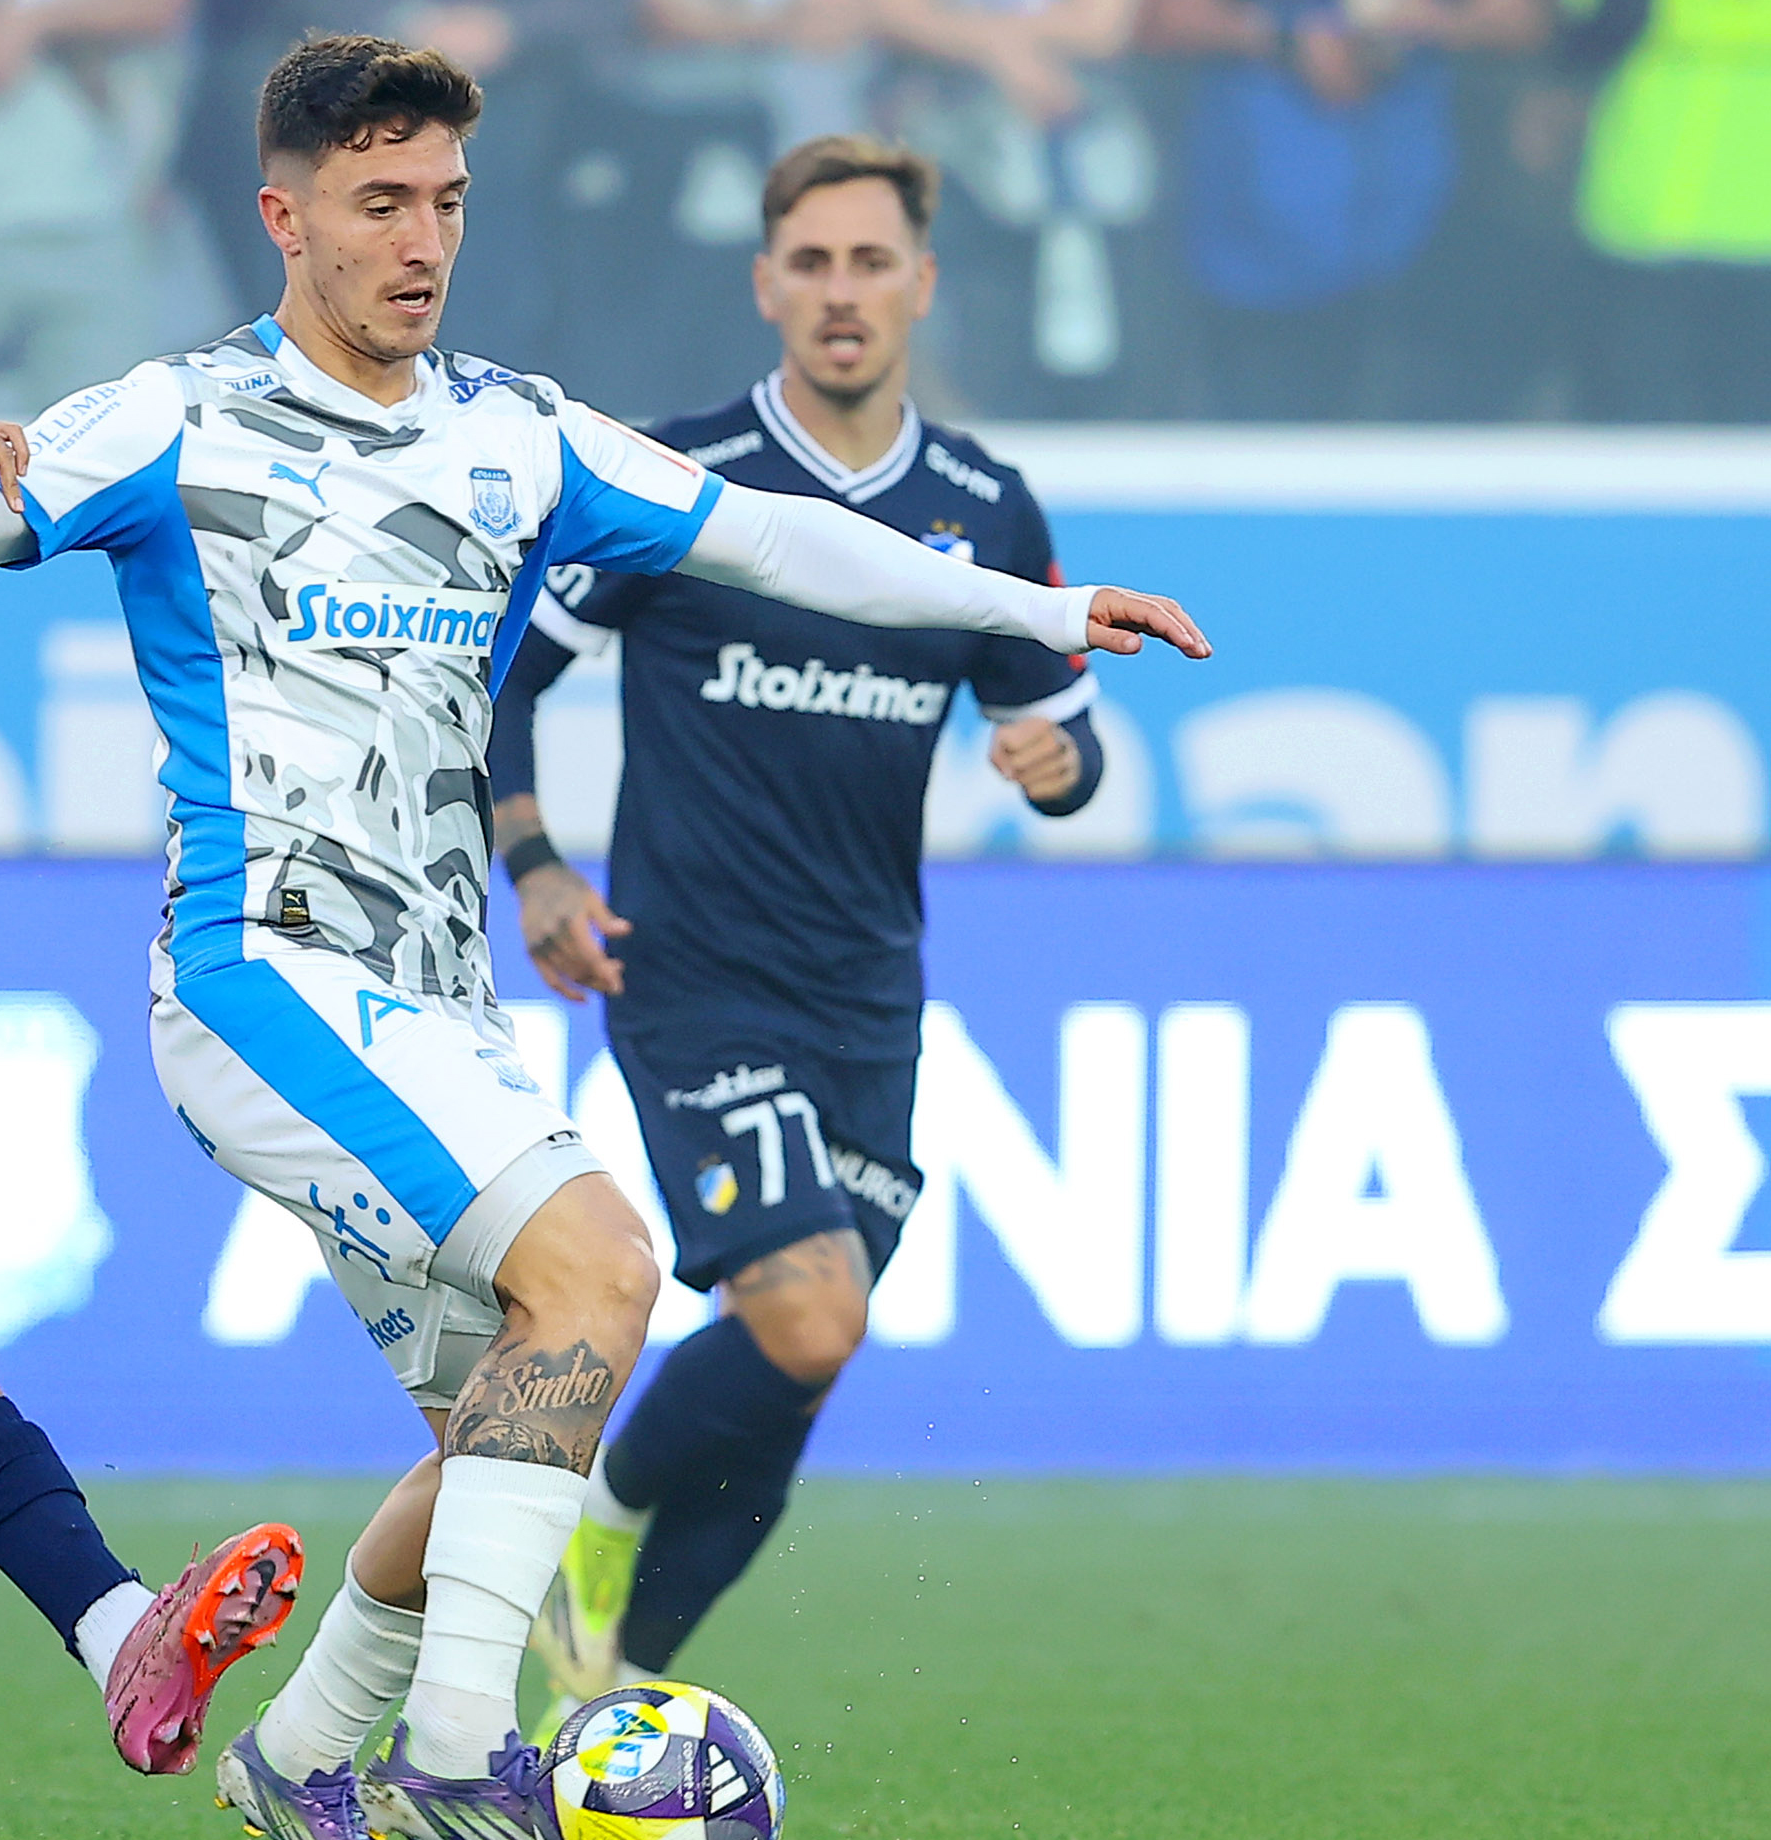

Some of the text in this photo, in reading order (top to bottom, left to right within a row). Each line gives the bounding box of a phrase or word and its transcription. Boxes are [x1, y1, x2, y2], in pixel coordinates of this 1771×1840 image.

[27, 379, 139, 457] OLUMBI
[56, 400, 122, 454] RESTAURANTS
[287, 583, 496, 647] Stoixima
[721, 1090, 837, 1208] 77
[364, 1307, 416, 1351] rkets
[497, 1347, 611, 1416] Simba
